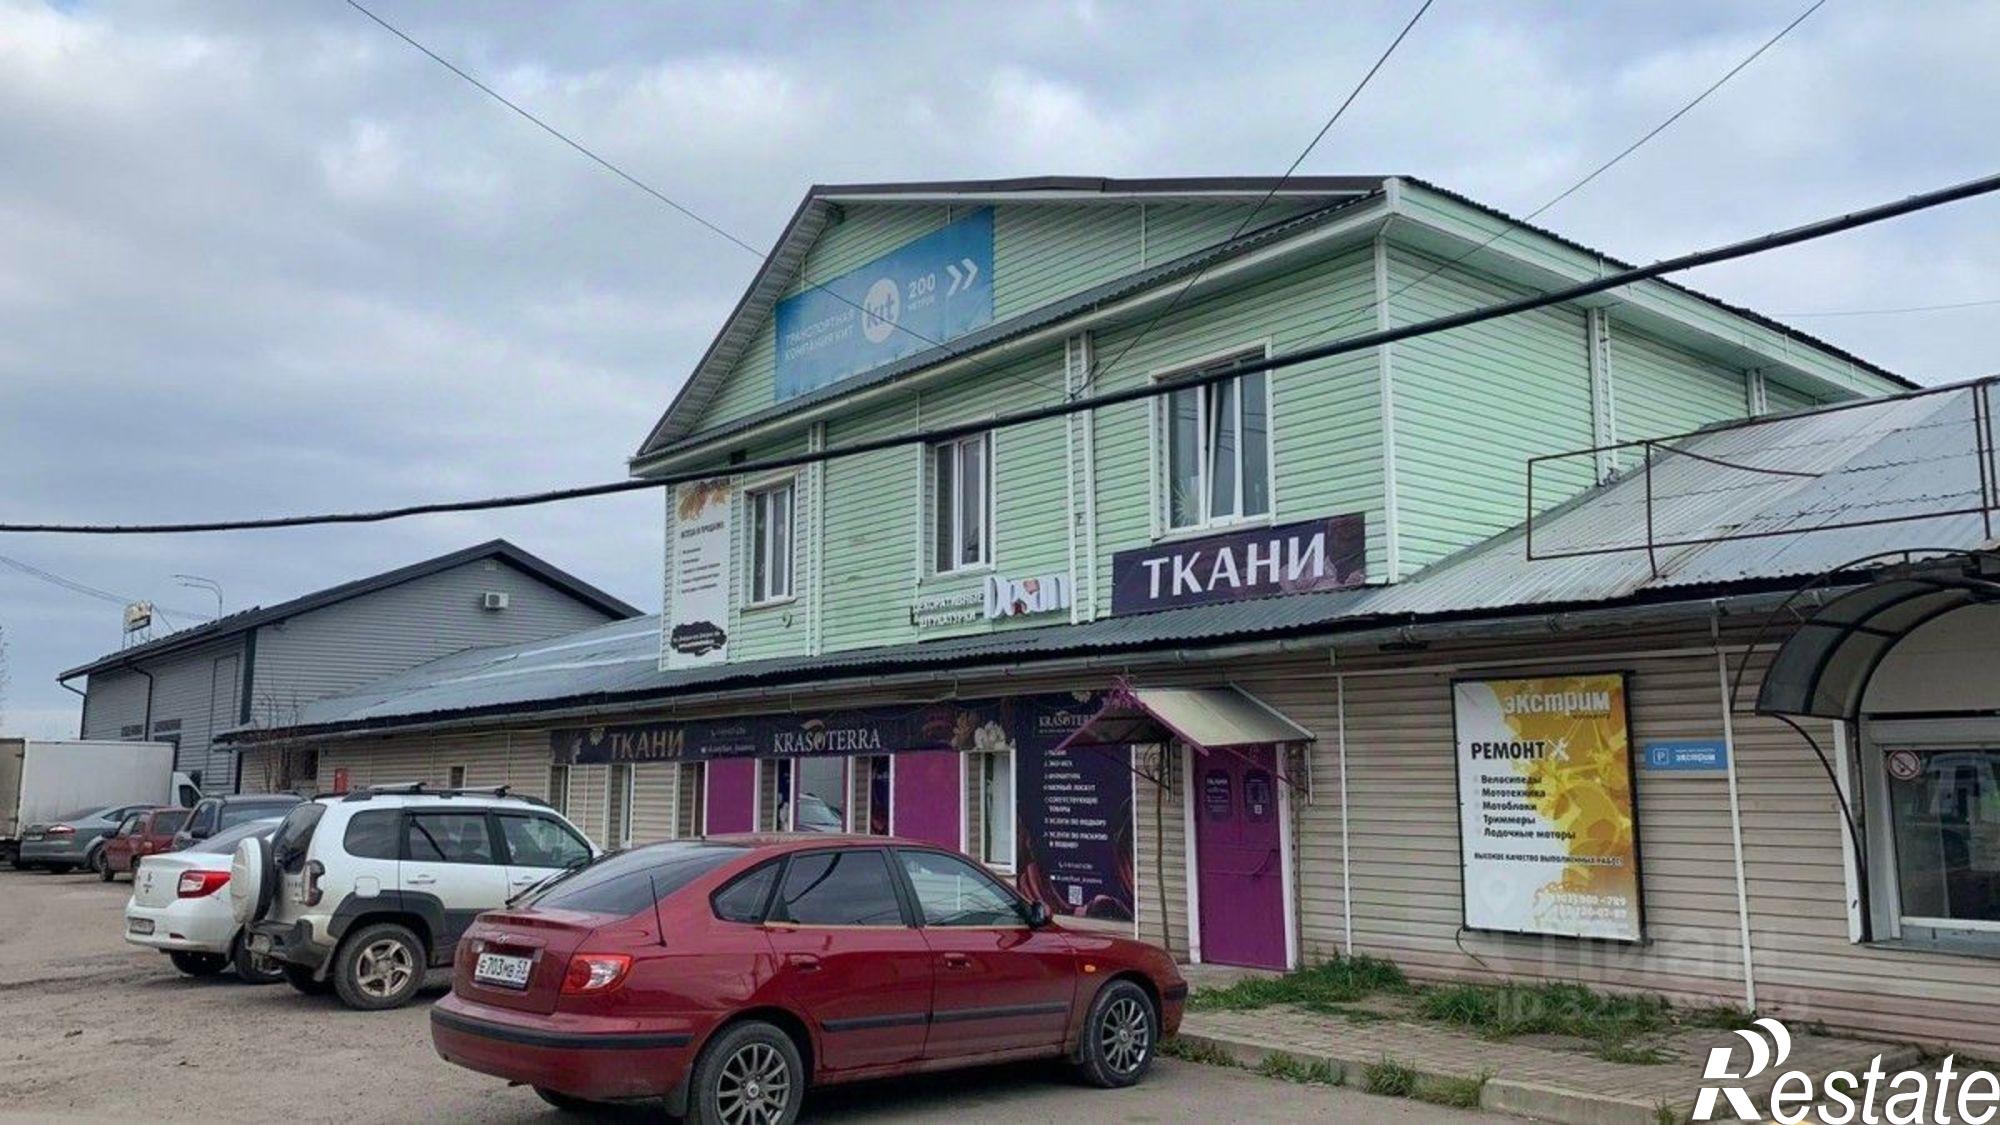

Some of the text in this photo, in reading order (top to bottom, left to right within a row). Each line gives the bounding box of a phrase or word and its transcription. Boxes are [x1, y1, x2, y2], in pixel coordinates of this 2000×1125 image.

[907, 273, 936, 299] 200
[1142, 533, 1325, 600] ТКАНИ
[609, 729, 684, 758] ТКАНИ
[773, 728, 881, 753] KRASOTERRA
[1471, 741, 1545, 760] РЕМОНТ
[1481, 774, 1542, 787] Велосипеды
[1482, 787, 1546, 798] Мототехника
[1482, 801, 1537, 811] Мотоблоки
[1484, 814, 1536, 826] Триммеры
[1484, 827, 1577, 841] Лодочные моторы
[1474, 852, 1504, 861] ВЫСОКОЕ
[1505, 853, 1539, 862] КАЧЕСТВО
